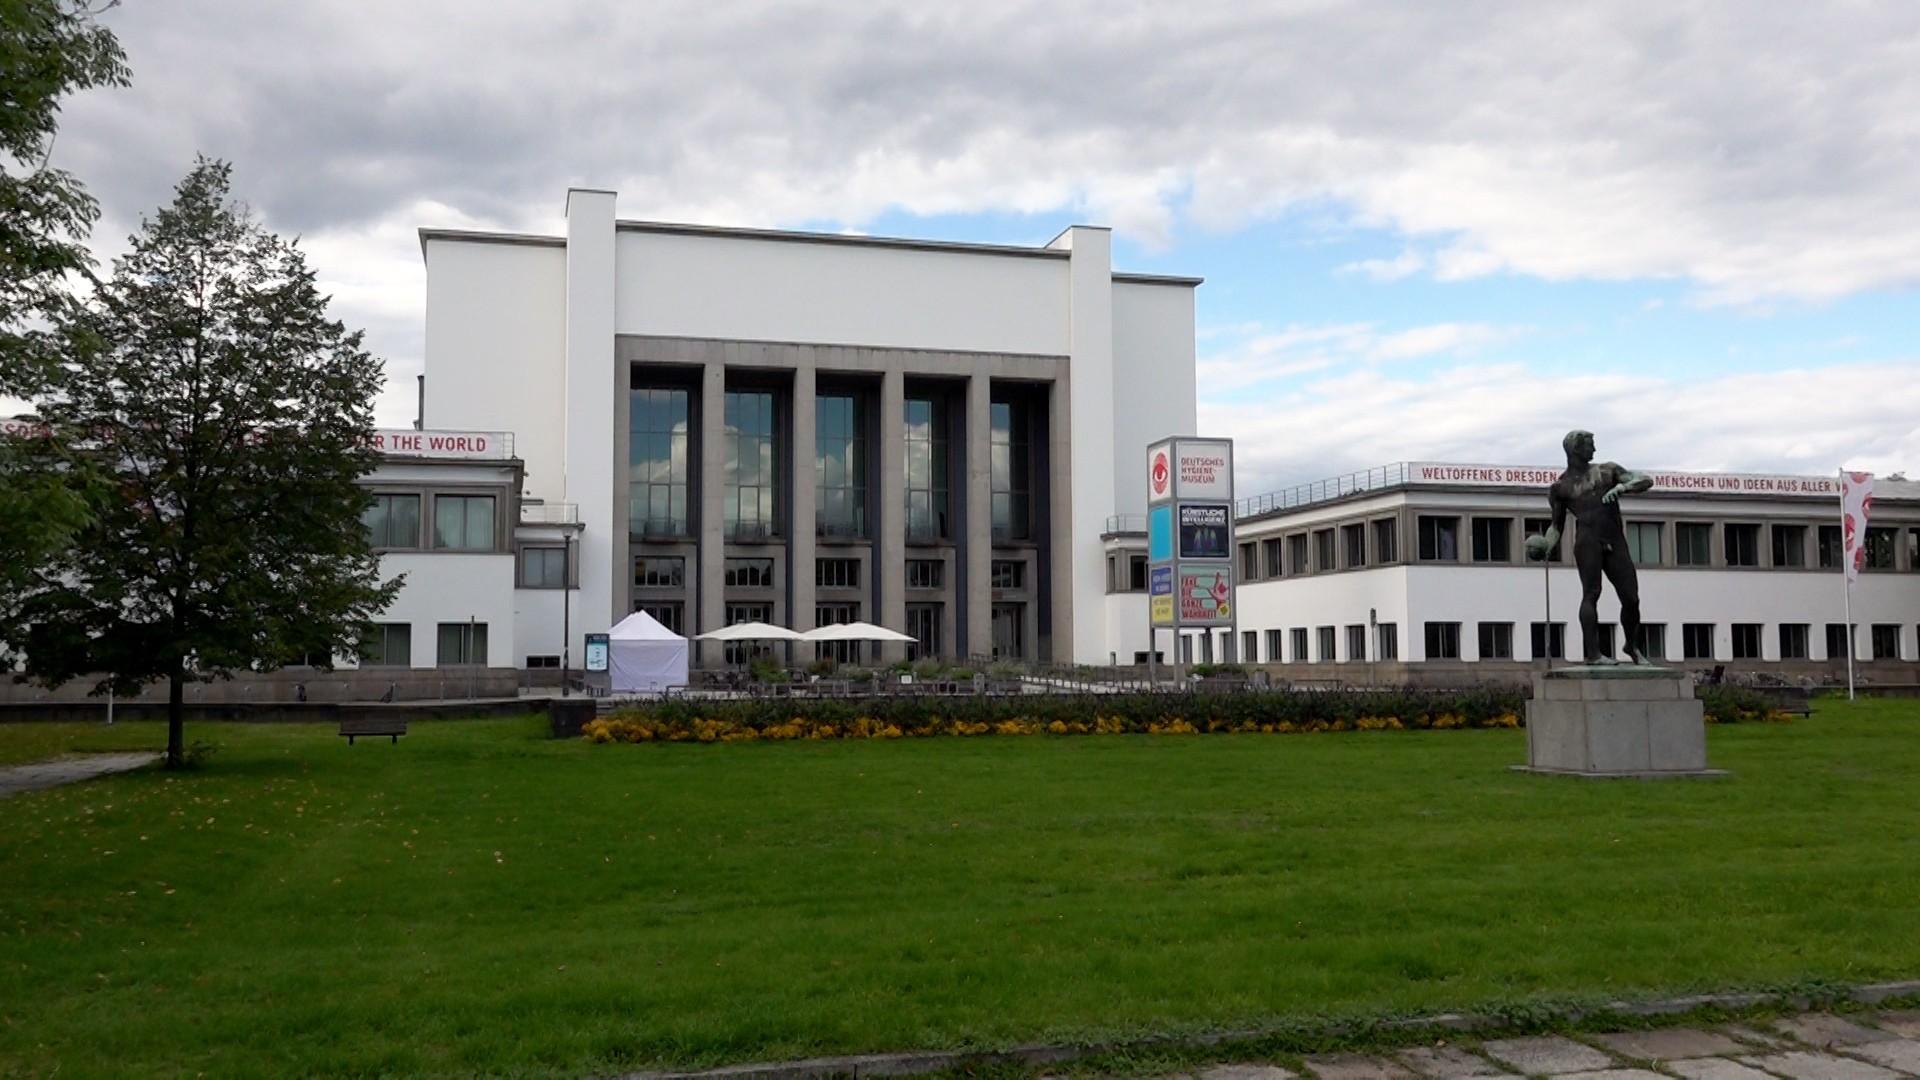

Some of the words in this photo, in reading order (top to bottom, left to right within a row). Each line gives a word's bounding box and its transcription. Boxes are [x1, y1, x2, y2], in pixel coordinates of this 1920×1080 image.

[391, 434, 422, 450] THE
[429, 436, 486, 452] WORLD
[1181, 458, 1225, 467] DEUTSCHES
[1181, 475, 1216, 484] MUSEUM
[1422, 467, 1502, 482] WELTOFFENES
[1506, 470, 1557, 483] DRESDEN
[1655, 475, 1715, 488] MENSCHEN
[1718, 478, 1740, 489] UND
[1743, 478, 1773, 491] IDEEN
[1776, 479, 1798, 492] AUS
[1801, 480, 1831, 492] ALLER
